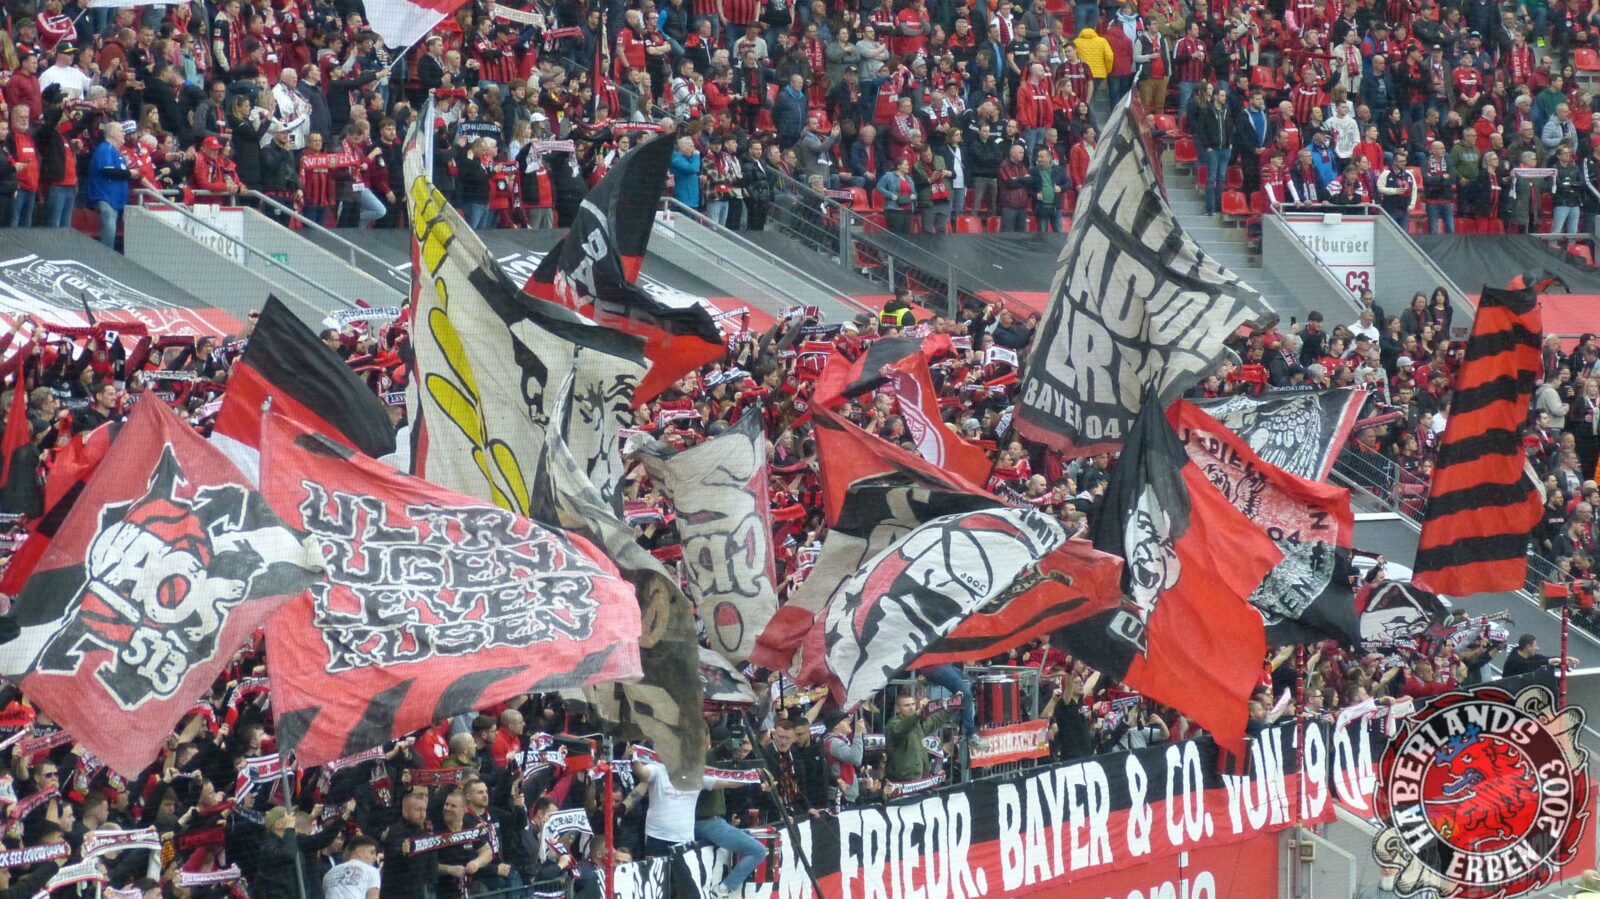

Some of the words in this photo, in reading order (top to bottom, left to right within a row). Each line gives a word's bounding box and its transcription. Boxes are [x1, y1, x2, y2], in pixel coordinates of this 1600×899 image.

[1346, 270, 1370, 293] C3
[1085, 415, 1121, 439] 04
[1267, 526, 1301, 546] 04
[838, 792, 988, 899] FRIEDR.
[998, 760, 1114, 892] BAYER
[1126, 754, 1153, 857] &
[1165, 740, 1214, 846] CO.
[1222, 727, 1292, 834] VON
